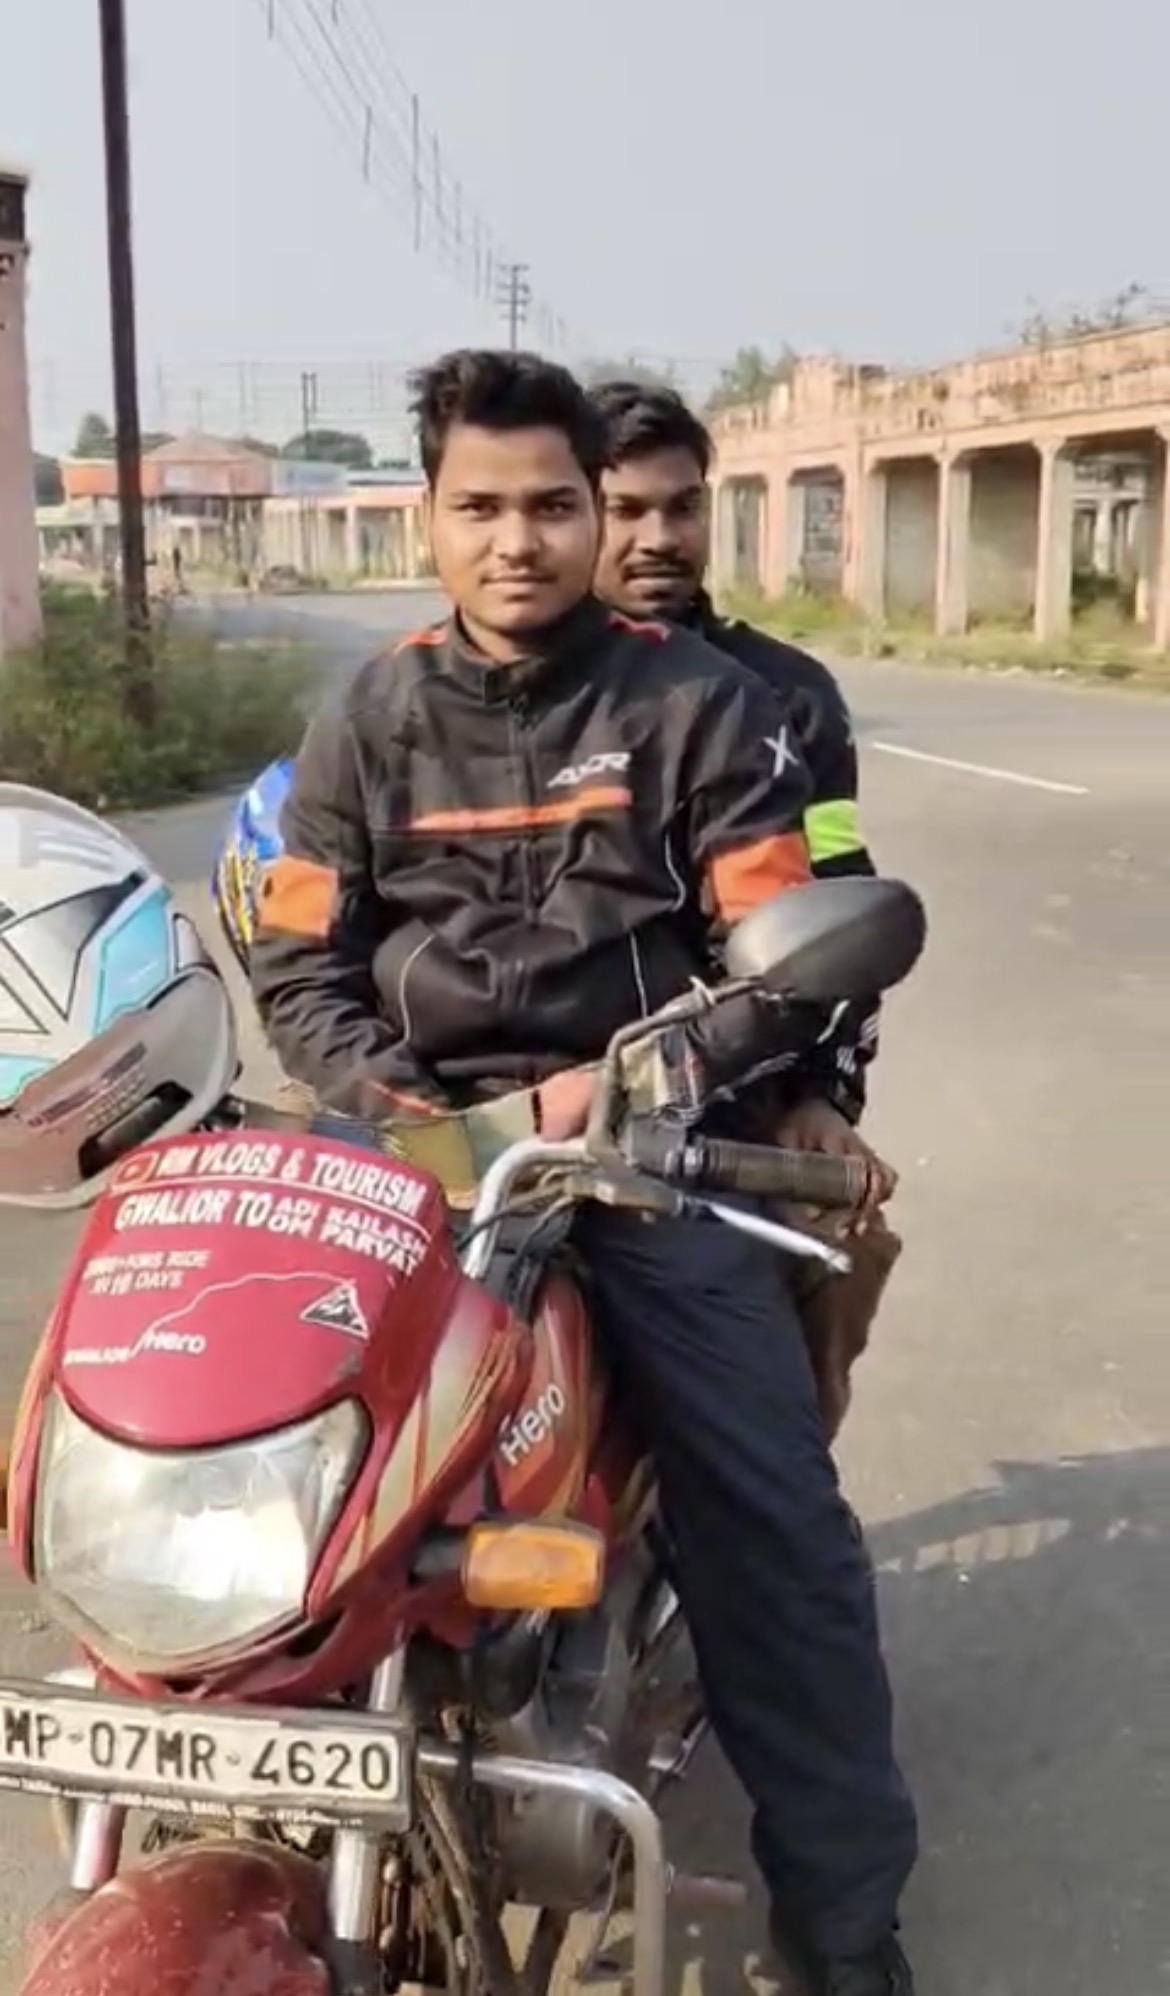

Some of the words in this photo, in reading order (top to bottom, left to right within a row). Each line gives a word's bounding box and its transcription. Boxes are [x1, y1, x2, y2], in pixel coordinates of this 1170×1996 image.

[114, 1188, 231, 1231] GWALIOR
[233, 1189, 271, 1228] TO
[197, 1141, 283, 1176] VLOGS
[280, 1147, 306, 1180] &
[310, 1153, 427, 1217] TOURISM
[267, 1215, 316, 1239] OM
[318, 1221, 419, 1277] PARVAT
[499, 1384, 566, 1468] Hero
[3, 1706, 61, 1759] MP
[90, 1721, 217, 1782] 07MR
[250, 1737, 391, 1792] 4620
